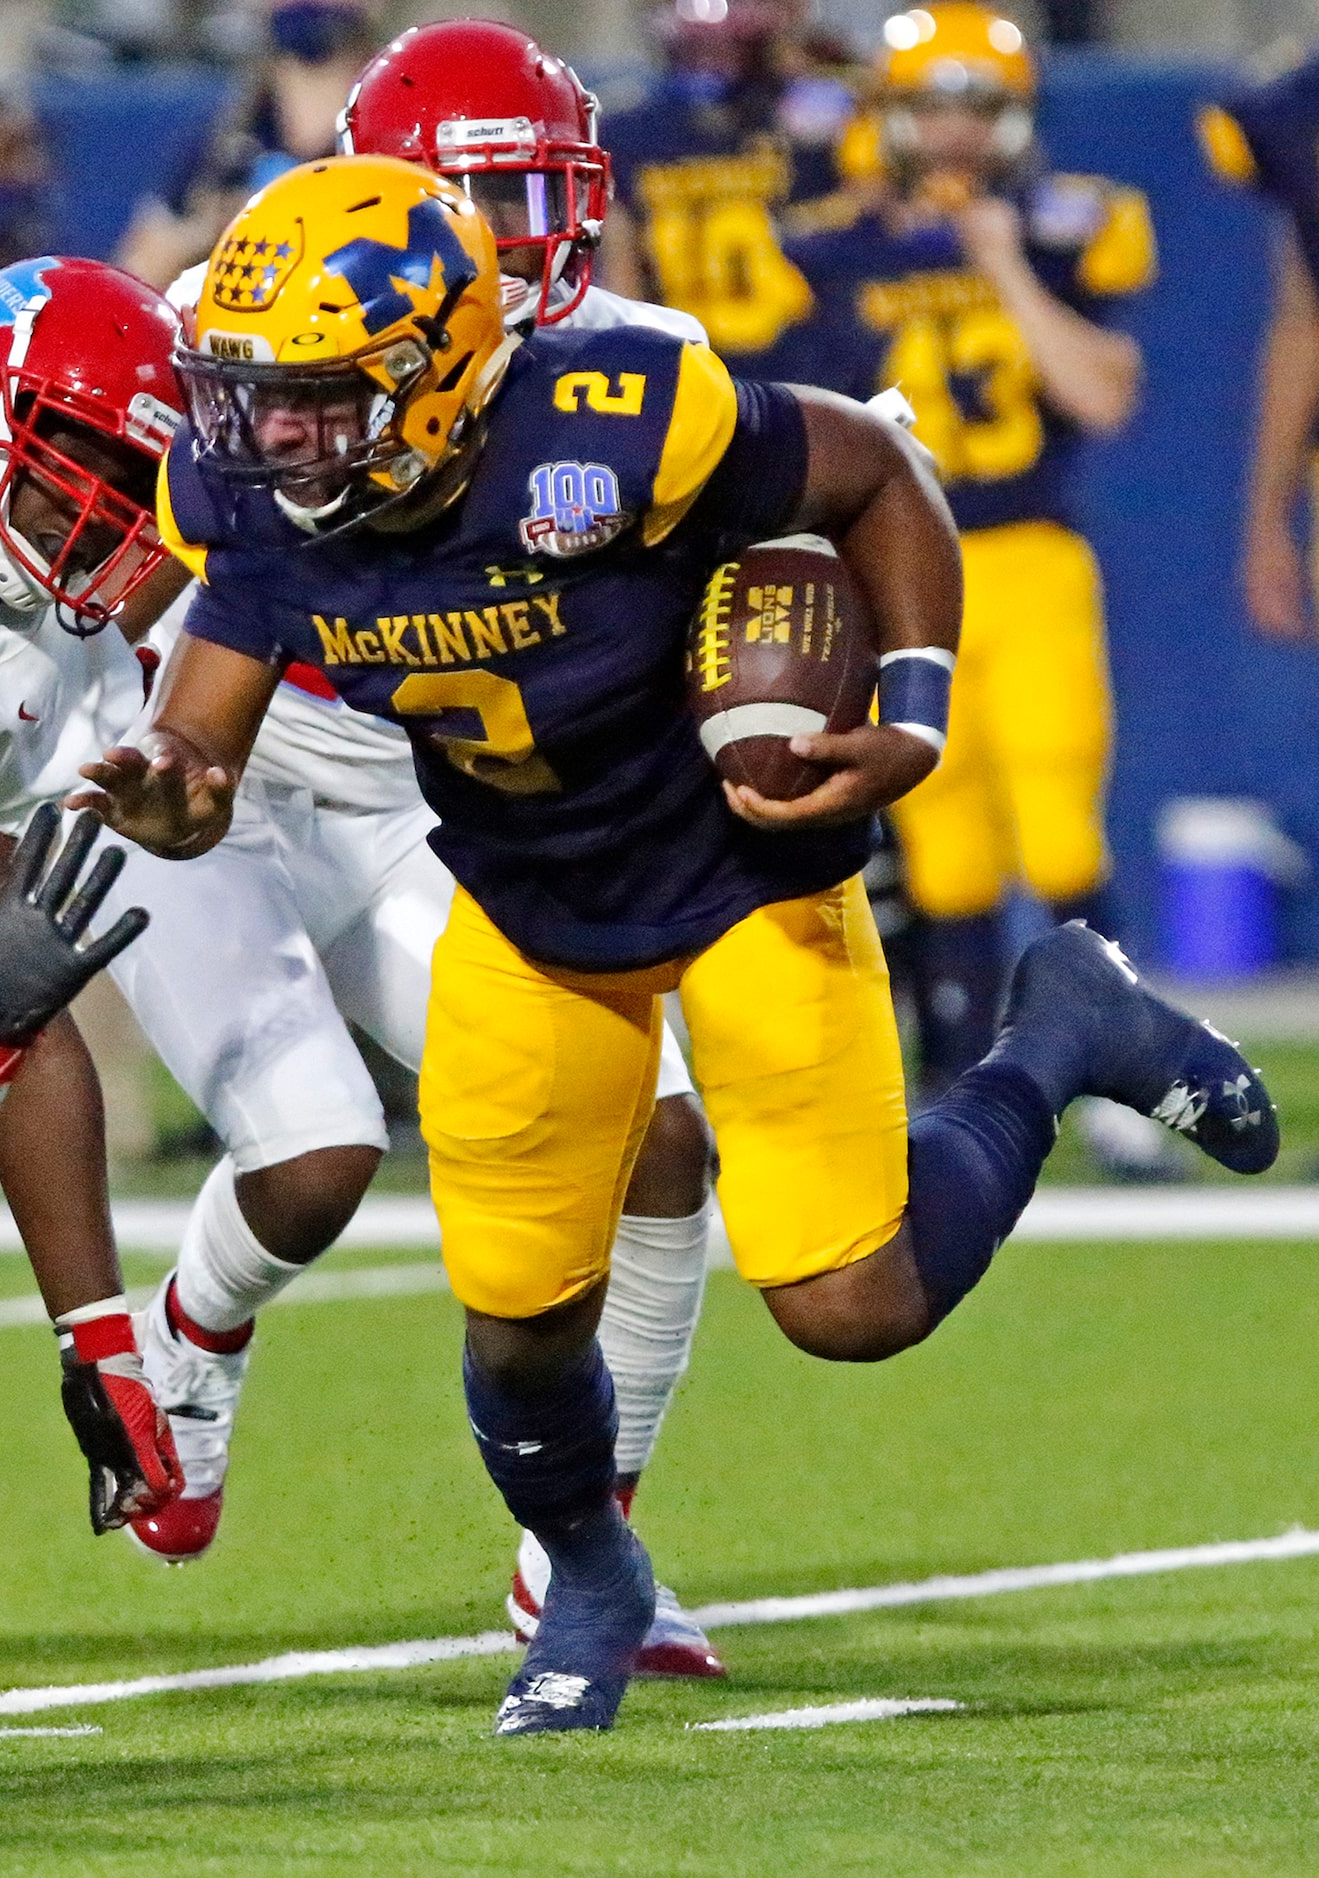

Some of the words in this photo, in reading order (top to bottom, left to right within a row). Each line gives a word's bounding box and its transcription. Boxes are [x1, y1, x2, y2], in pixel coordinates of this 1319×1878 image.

[467, 127, 504, 138] schutt
[209, 334, 254, 359] WAWG
[553, 370, 647, 416] 2
[154, 410, 178, 430] schut
[530, 461, 621, 520] 100
[312, 590, 567, 666] McKINNEY
[760, 584, 777, 644] LIONS
[390, 667, 564, 794] 2
